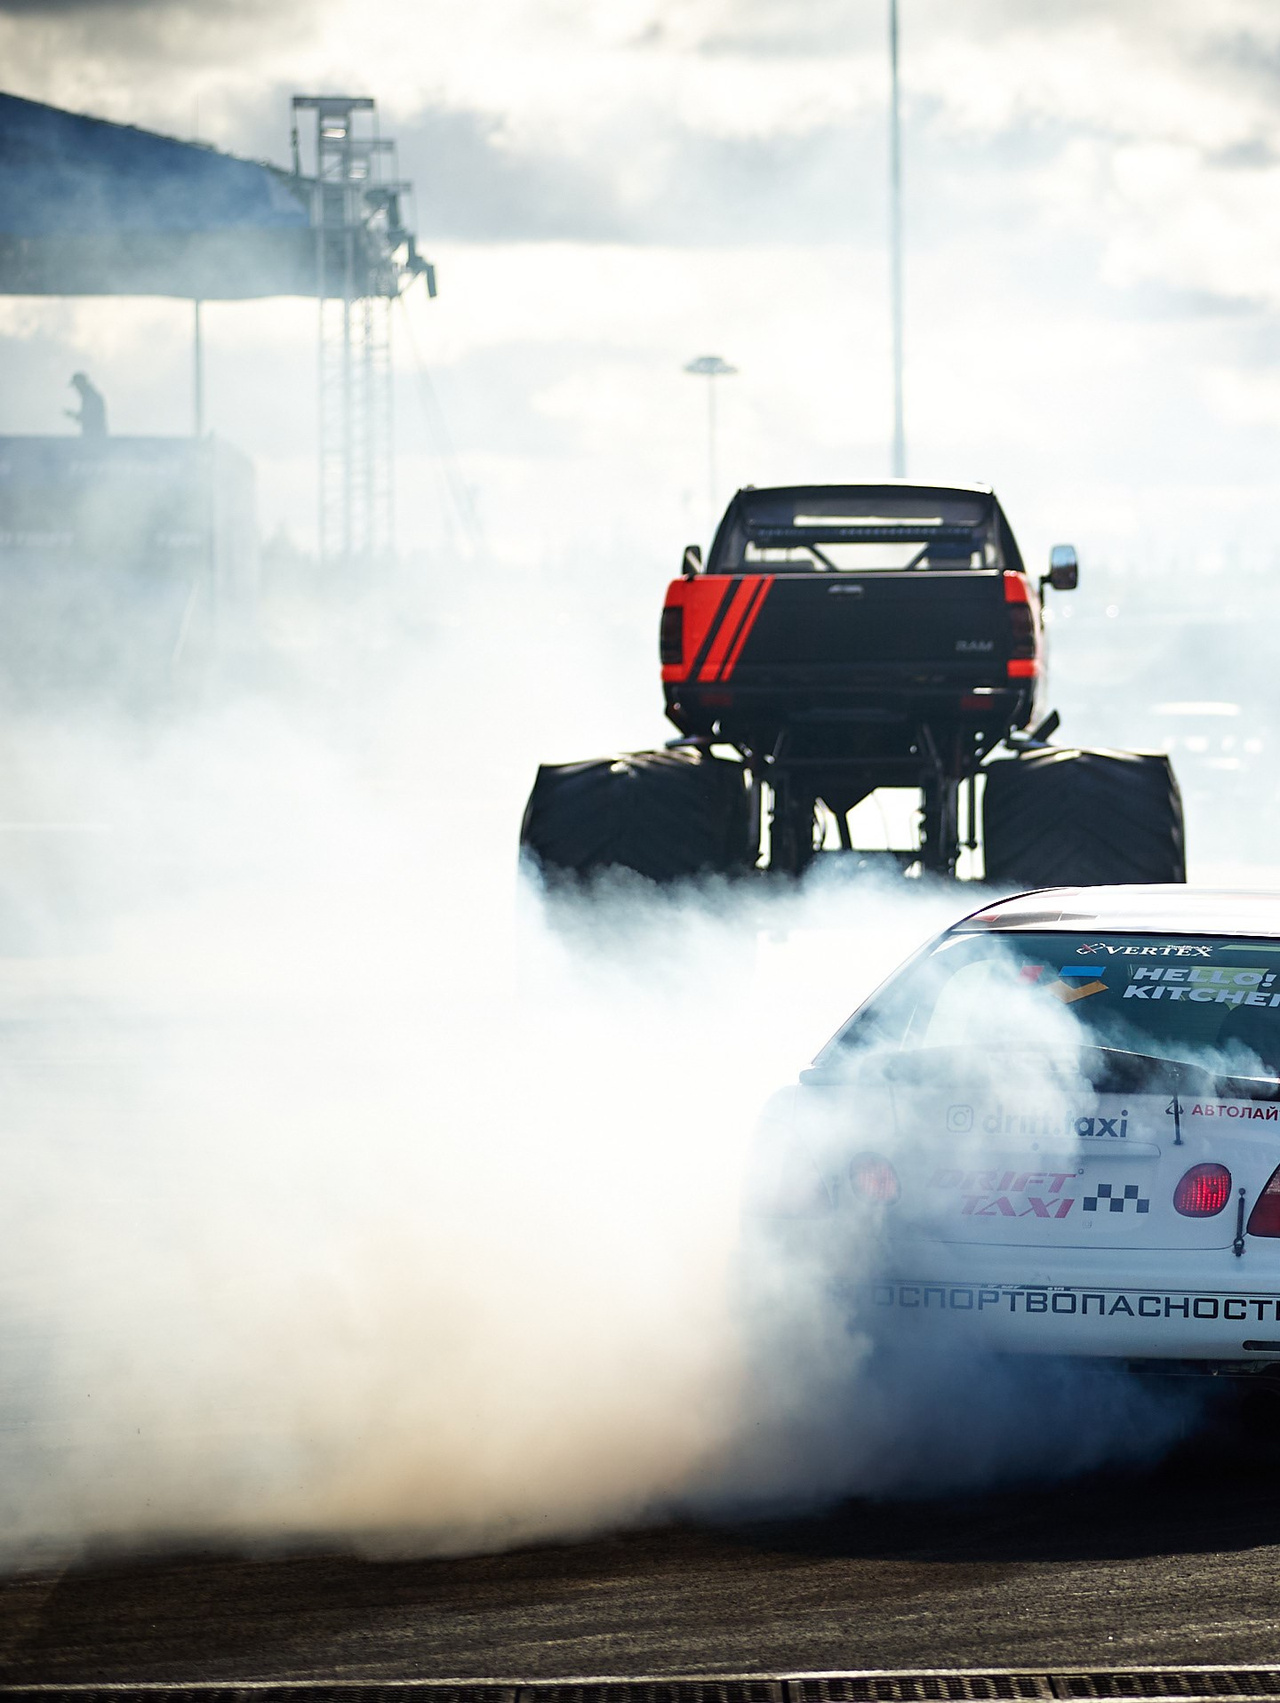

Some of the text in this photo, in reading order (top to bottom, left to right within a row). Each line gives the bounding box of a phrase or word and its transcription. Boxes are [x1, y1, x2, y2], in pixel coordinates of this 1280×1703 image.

[1105, 945, 1213, 958] VERTEX
[1133, 967, 1277, 988] HELLO!
[926, 1168, 1078, 1194] DRIFT
[961, 1194, 1076, 1219] TAXI
